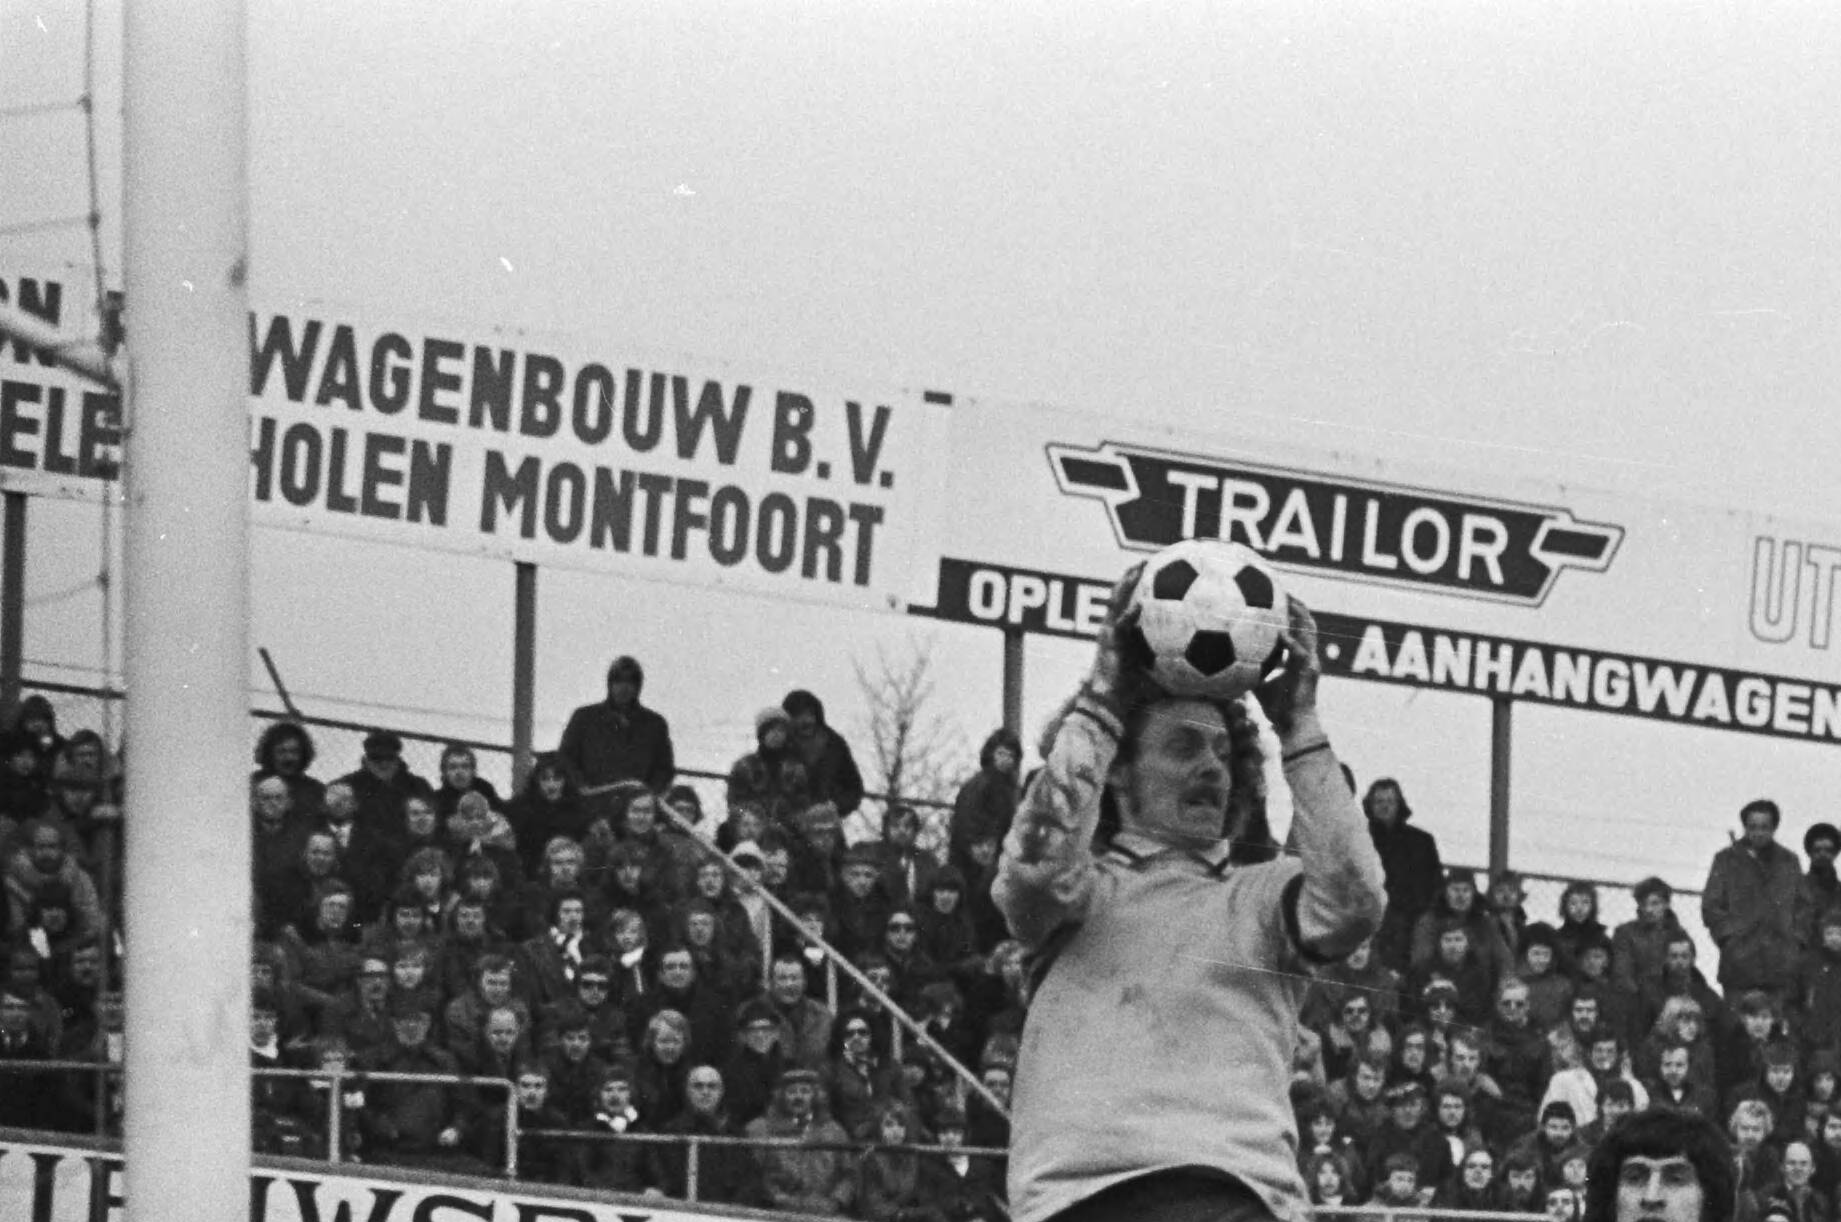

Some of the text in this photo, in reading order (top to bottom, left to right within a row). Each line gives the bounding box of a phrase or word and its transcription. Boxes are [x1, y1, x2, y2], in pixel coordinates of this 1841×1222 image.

[248, 311, 752, 466] WAGENBOUW
[479, 449, 886, 588] MONTFOORT
[1166, 470, 1508, 587] TRAILOR
[968, 568, 1109, 638] OPLE
